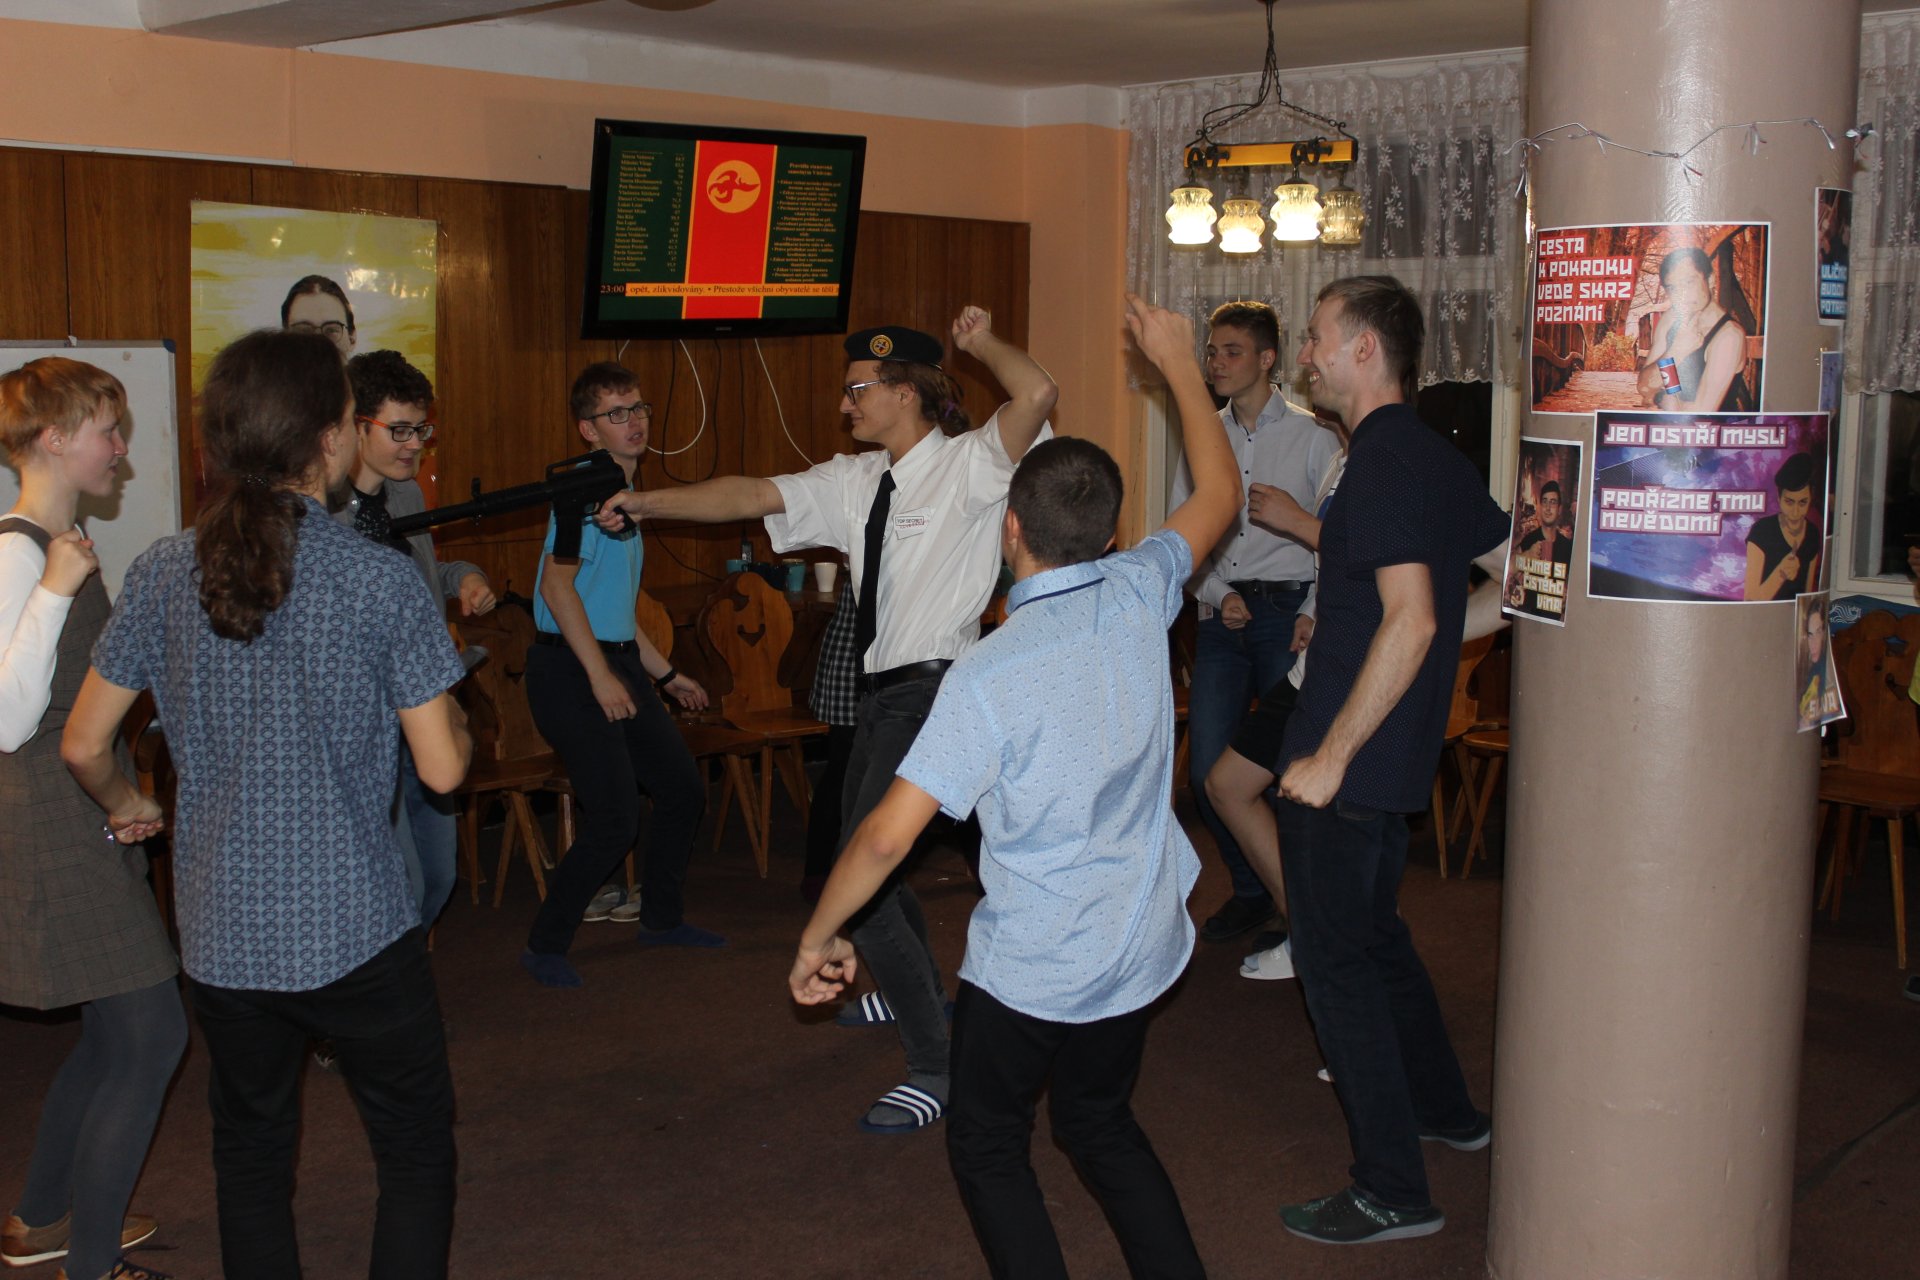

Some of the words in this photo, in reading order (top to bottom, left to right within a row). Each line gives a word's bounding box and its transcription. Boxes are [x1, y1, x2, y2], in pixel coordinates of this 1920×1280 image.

[1539, 237, 1585, 256] CESTA
[1538, 262, 1546, 278] K
[1549, 258, 1633, 278] POKROKU
[600, 284, 625, 294] 23:00
[714, 285, 745, 293] Přestože
[748, 285, 774, 293] všichni
[1537, 283, 1574, 300] VEDE
[1579, 281, 1632, 299] SKRZ
[1536, 301, 1604, 322] POZNÁNÍ
[1606, 426, 1645, 443] JEN
[1651, 424, 1717, 445] OSTŘÍ
[1722, 427, 1786, 446] MYSLI
[1603, 488, 1711, 511] PROŘÍZNE
[1718, 494, 1765, 515] TMU
[1602, 510, 1720, 532] NEVĚDOMÍ
